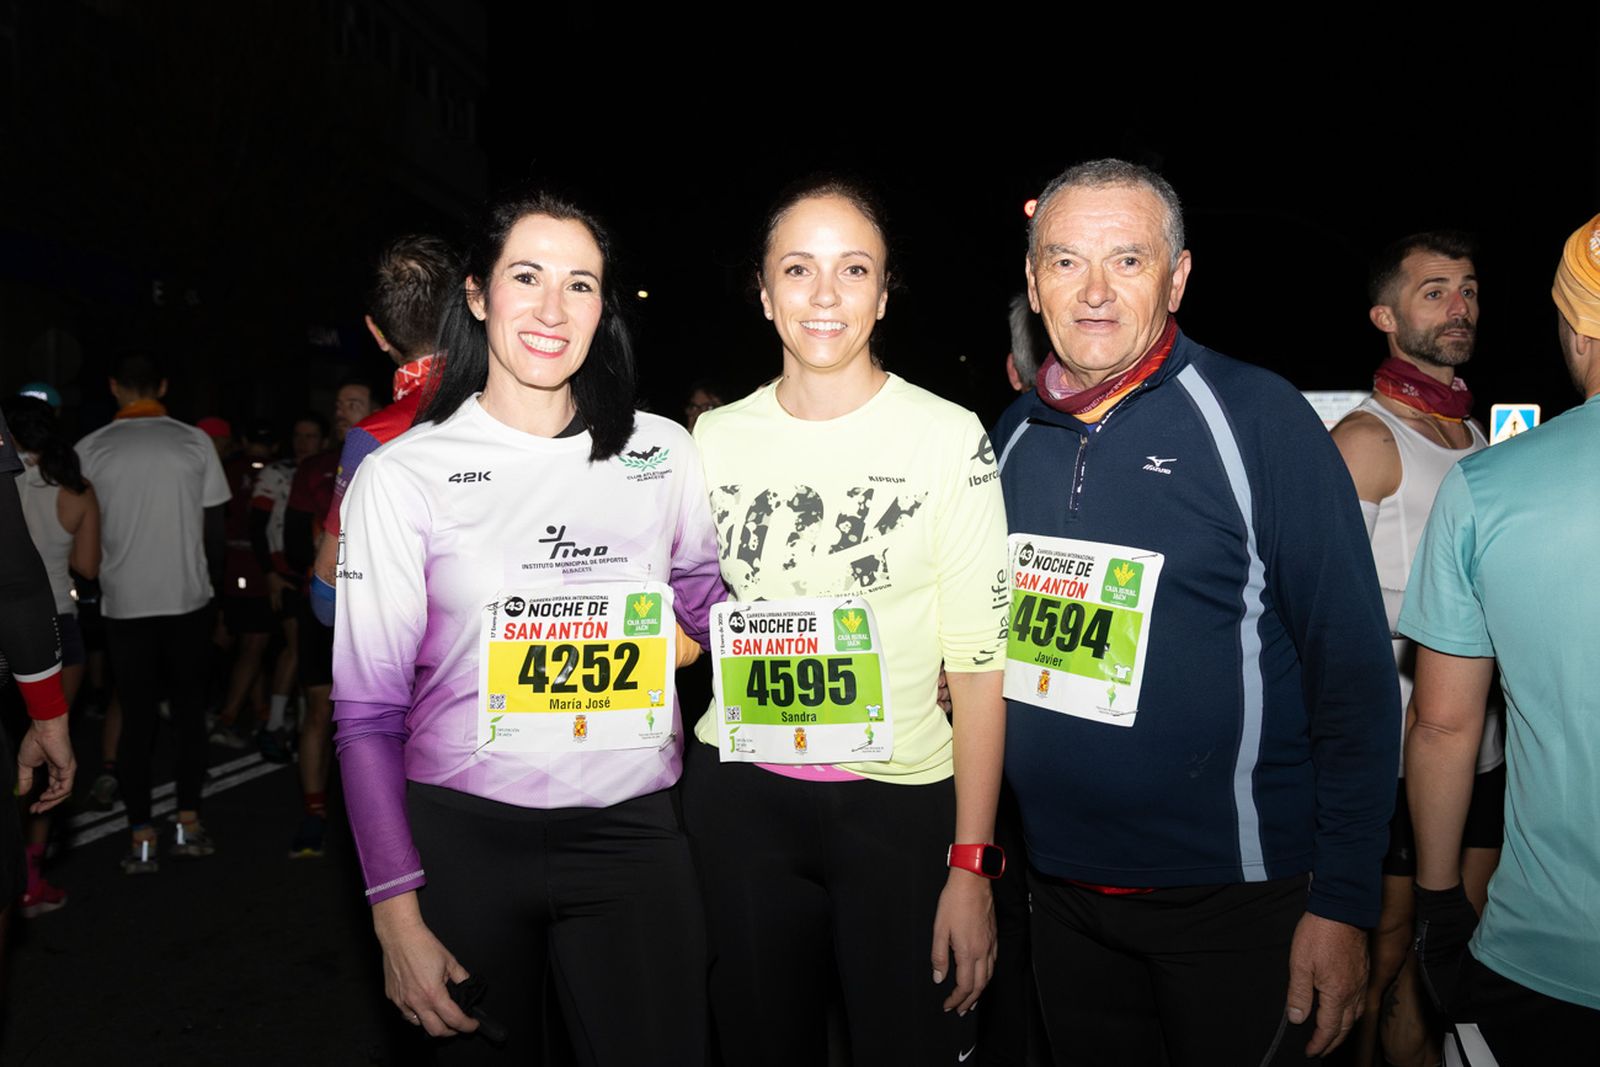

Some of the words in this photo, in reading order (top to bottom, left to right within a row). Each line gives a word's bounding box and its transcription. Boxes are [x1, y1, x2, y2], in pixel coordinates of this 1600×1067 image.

[448, 470, 492, 483] 42K
[1020, 549, 1033, 561] 43
[555, 560, 589, 568] MUNICIPAL
[1032, 555, 1075, 574] NOCHE
[1075, 561, 1094, 578] DE
[992, 569, 1009, 610] life
[1015, 571, 1041, 591] SAN
[1039, 577, 1089, 599] ANTÓN
[505, 601, 524, 612] 43
[528, 602, 584, 617] NOCHE
[587, 601, 608, 616] DE
[504, 622, 542, 640] SAN
[545, 617, 608, 640] ANTÓN
[730, 616, 744, 628] 43
[749, 618, 793, 634] NOCHE
[797, 618, 817, 632] DE
[1012, 595, 1113, 660] 4594
[732, 639, 762, 655] SAN
[765, 633, 818, 655] ANTÓN
[1034, 651, 1063, 667] Javier
[518, 642, 640, 694] 4252
[747, 658, 857, 708] 4595
[550, 698, 582, 710] María
[585, 697, 610, 709] José
[781, 711, 817, 723] Sandra
